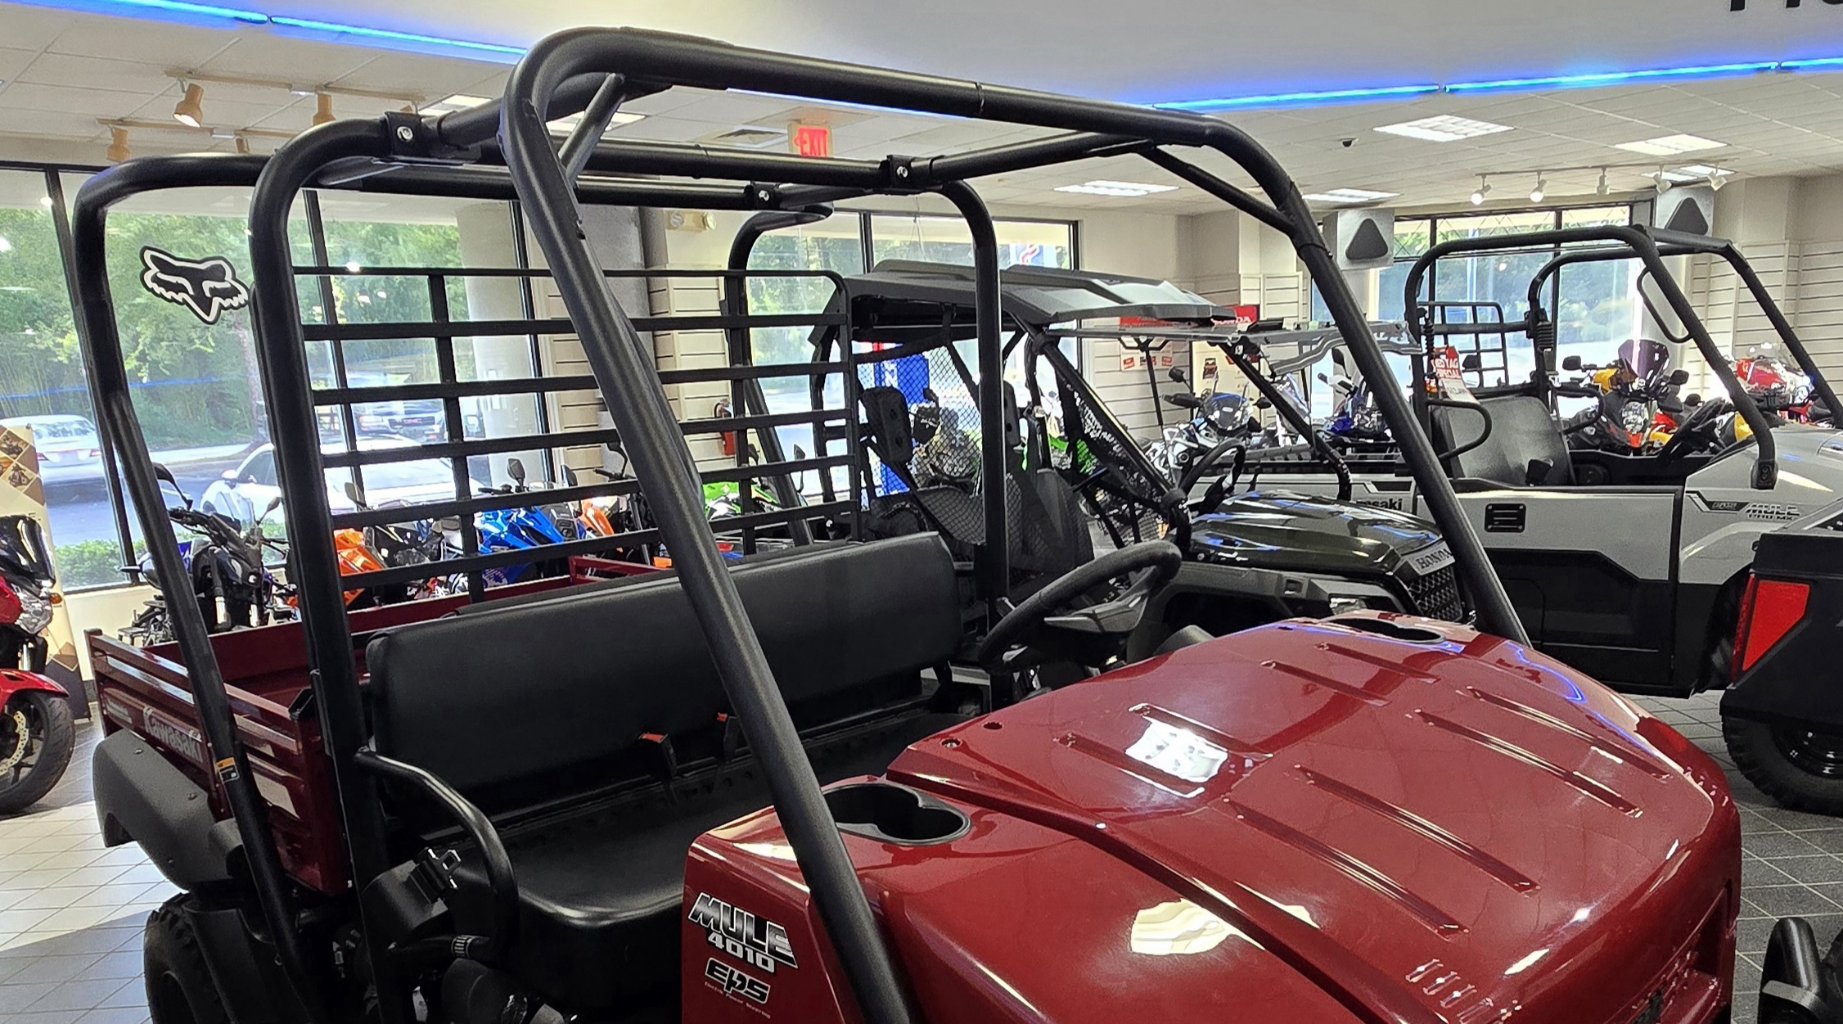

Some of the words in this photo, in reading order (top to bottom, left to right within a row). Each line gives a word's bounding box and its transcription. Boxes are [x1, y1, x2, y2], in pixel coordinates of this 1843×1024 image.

[798, 127, 828, 158] EXIT
[1745, 503, 1801, 516] MULE
[1416, 547, 1454, 570] HONDA
[143, 705, 204, 764] Kawasaki
[688, 892, 798, 969] MULE
[707, 931, 775, 973] 4010
[704, 957, 771, 1004] EPS
